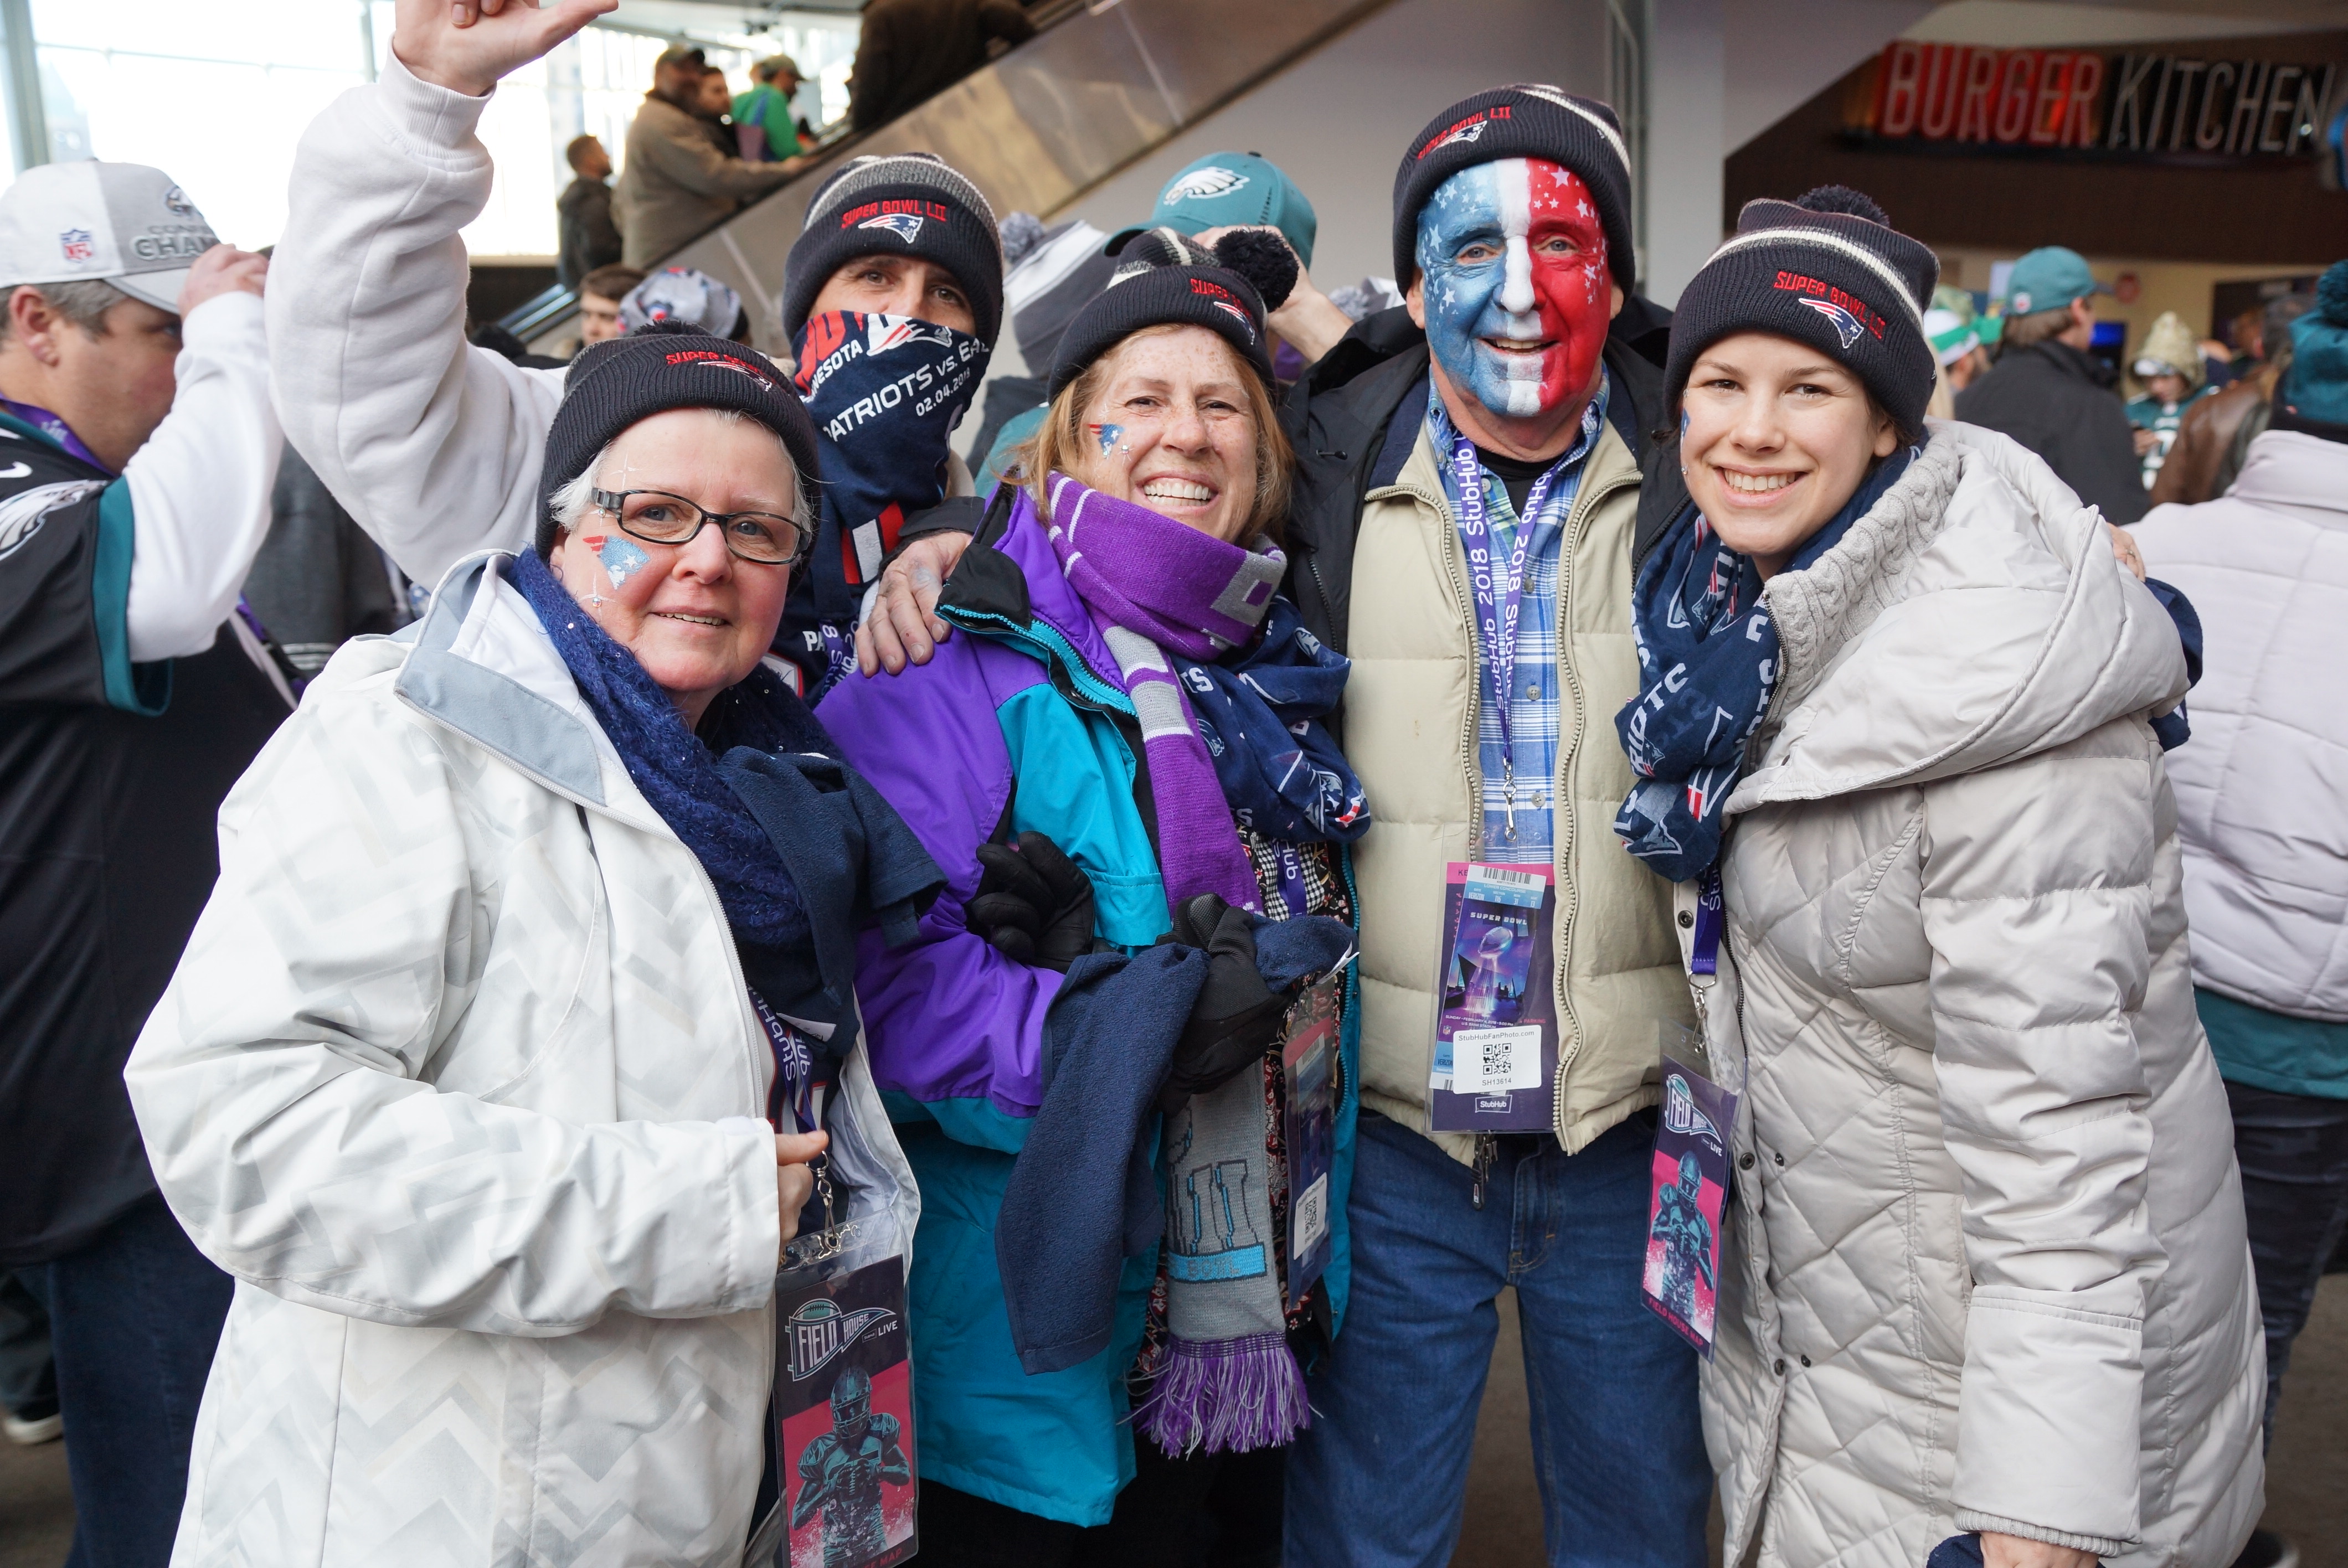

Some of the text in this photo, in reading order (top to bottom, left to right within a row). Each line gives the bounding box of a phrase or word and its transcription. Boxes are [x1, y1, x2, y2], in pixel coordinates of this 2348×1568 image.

[1882, 42, 2336, 156] BURGER KITCHEN
[1490, 106, 1511, 119] LII
[841, 199, 947, 229] SUPER BOWL LII
[1191, 278, 1229, 298] SUPER
[1774, 271, 1886, 340] SUPER BOWL LII
[666, 352, 719, 366] SUPER
[936, 355, 958, 376] VS.
[1454, 448, 1484, 536] StubHub
[1507, 535, 1528, 592] 2018
[1470, 548, 1493, 606] 2018
[1504, 604, 1519, 698] StubHub
[1484, 618, 1504, 710] StubHub
[1469, 892, 1485, 901] VERIZON
[1470, 912, 1501, 922] SUPER
[1459, 1030, 1535, 1041] StubHubFanPhoto.com
[1482, 1078, 1512, 1086] SH13614
[1671, 1089, 1691, 1128] FIELD
[1710, 1141, 1722, 1157] LIVE
[878, 1320, 898, 1337] LIVE
[1649, 1297, 1703, 1347] FIELD HOUSE MAP
[797, 1312, 869, 1372] FIELD HOUSE
[879, 1547, 903, 1567] MAP
